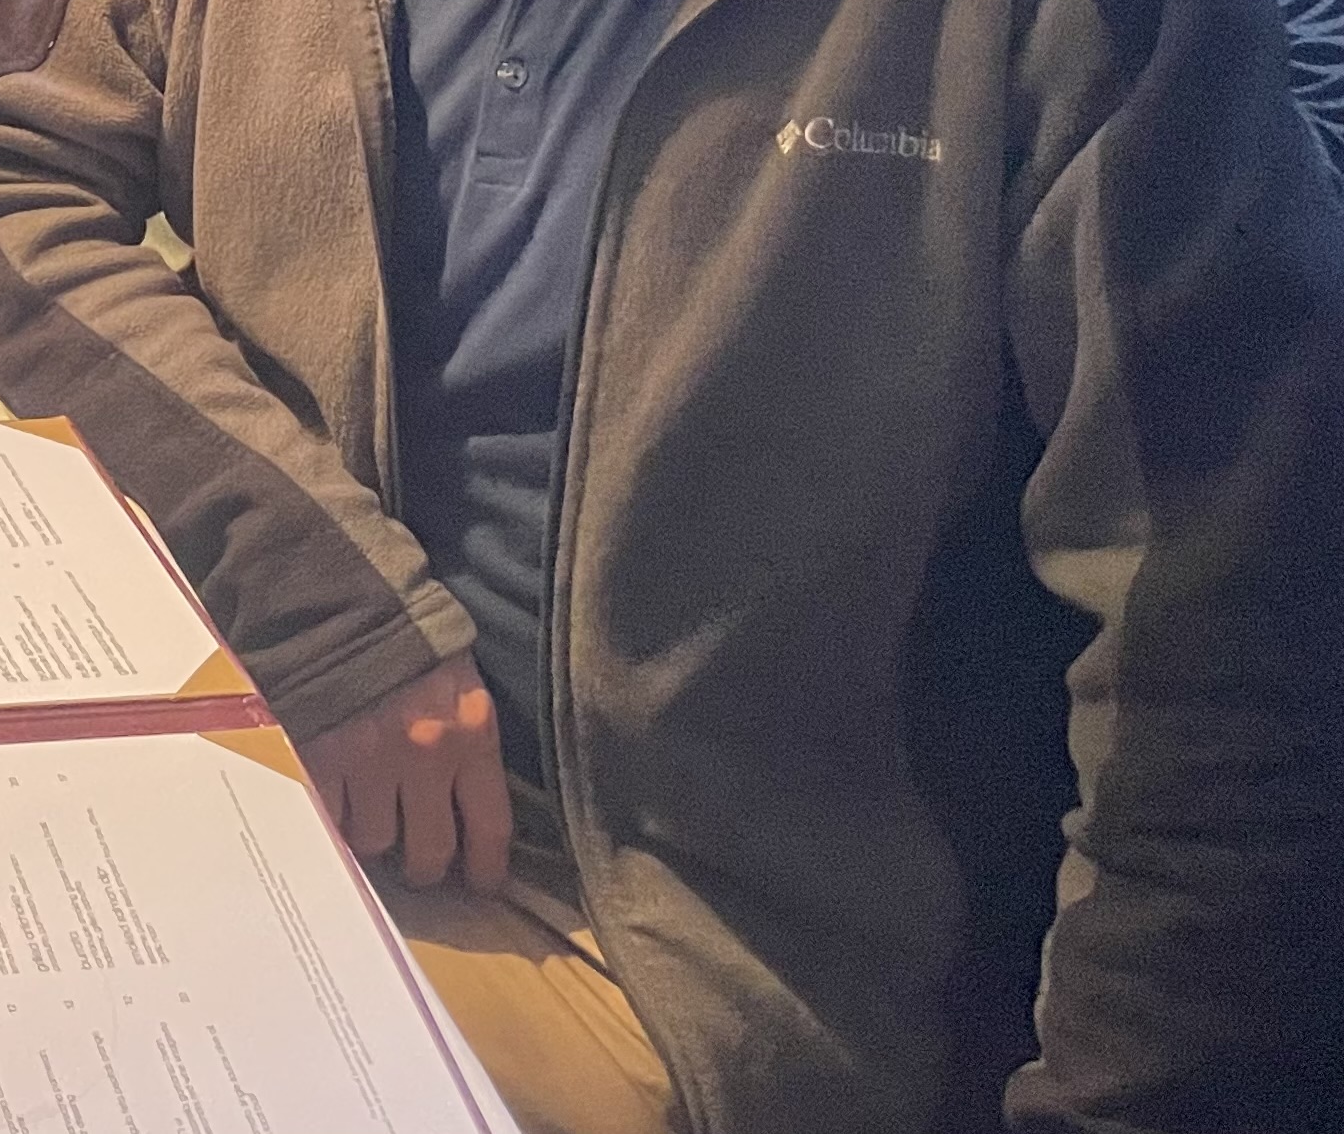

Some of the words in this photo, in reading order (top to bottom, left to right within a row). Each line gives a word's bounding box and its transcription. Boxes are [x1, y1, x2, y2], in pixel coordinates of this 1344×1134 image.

[805, 117, 941, 162] Columbia
[104, 885, 126, 922] salmon
[28, 942, 49, 972] grilled
[118, 924, 144, 965] smoked
